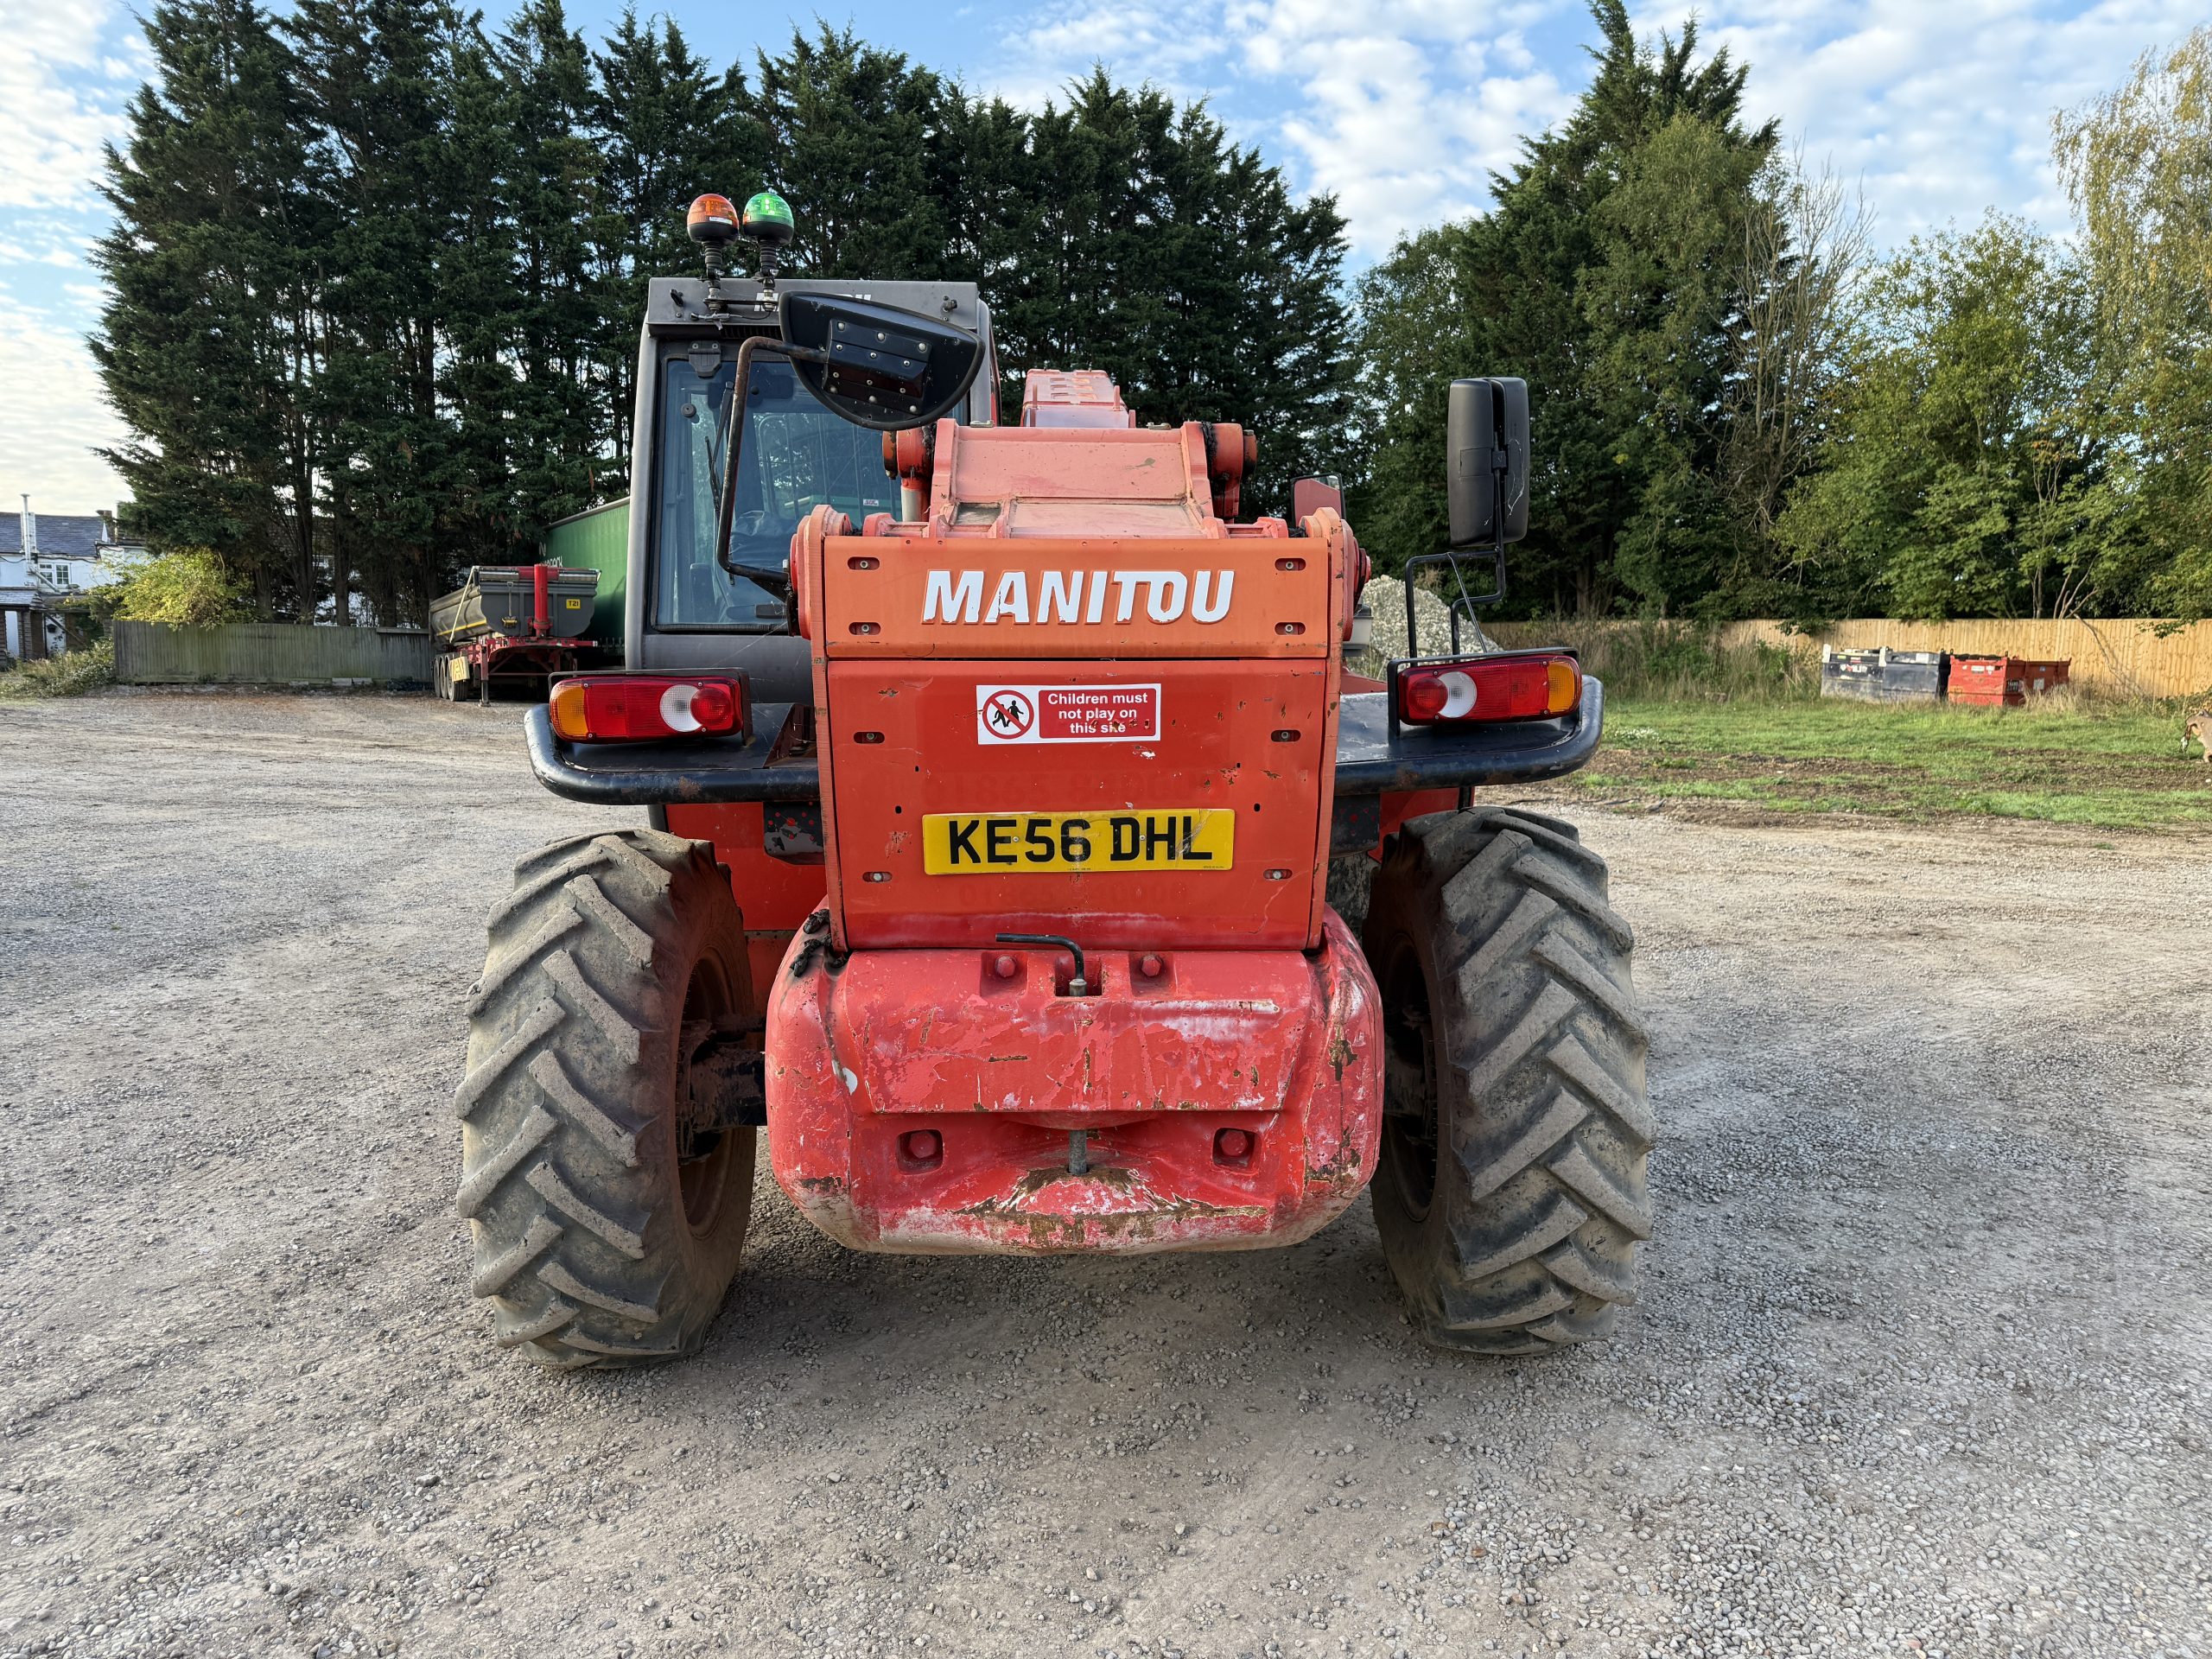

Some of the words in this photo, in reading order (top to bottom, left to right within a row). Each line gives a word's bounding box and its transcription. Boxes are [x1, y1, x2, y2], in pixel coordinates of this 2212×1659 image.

[921, 569, 1236, 625] MANITOU
[1047, 693, 1109, 705] Children
[1112, 692, 1148, 704] must
[1058, 709, 1082, 719] not
[1086, 708, 1116, 721] play
[1119, 709, 1137, 718] on
[1070, 722, 1096, 734] this
[948, 818, 1092, 864] KE56
[1109, 816, 1213, 861] DHL
